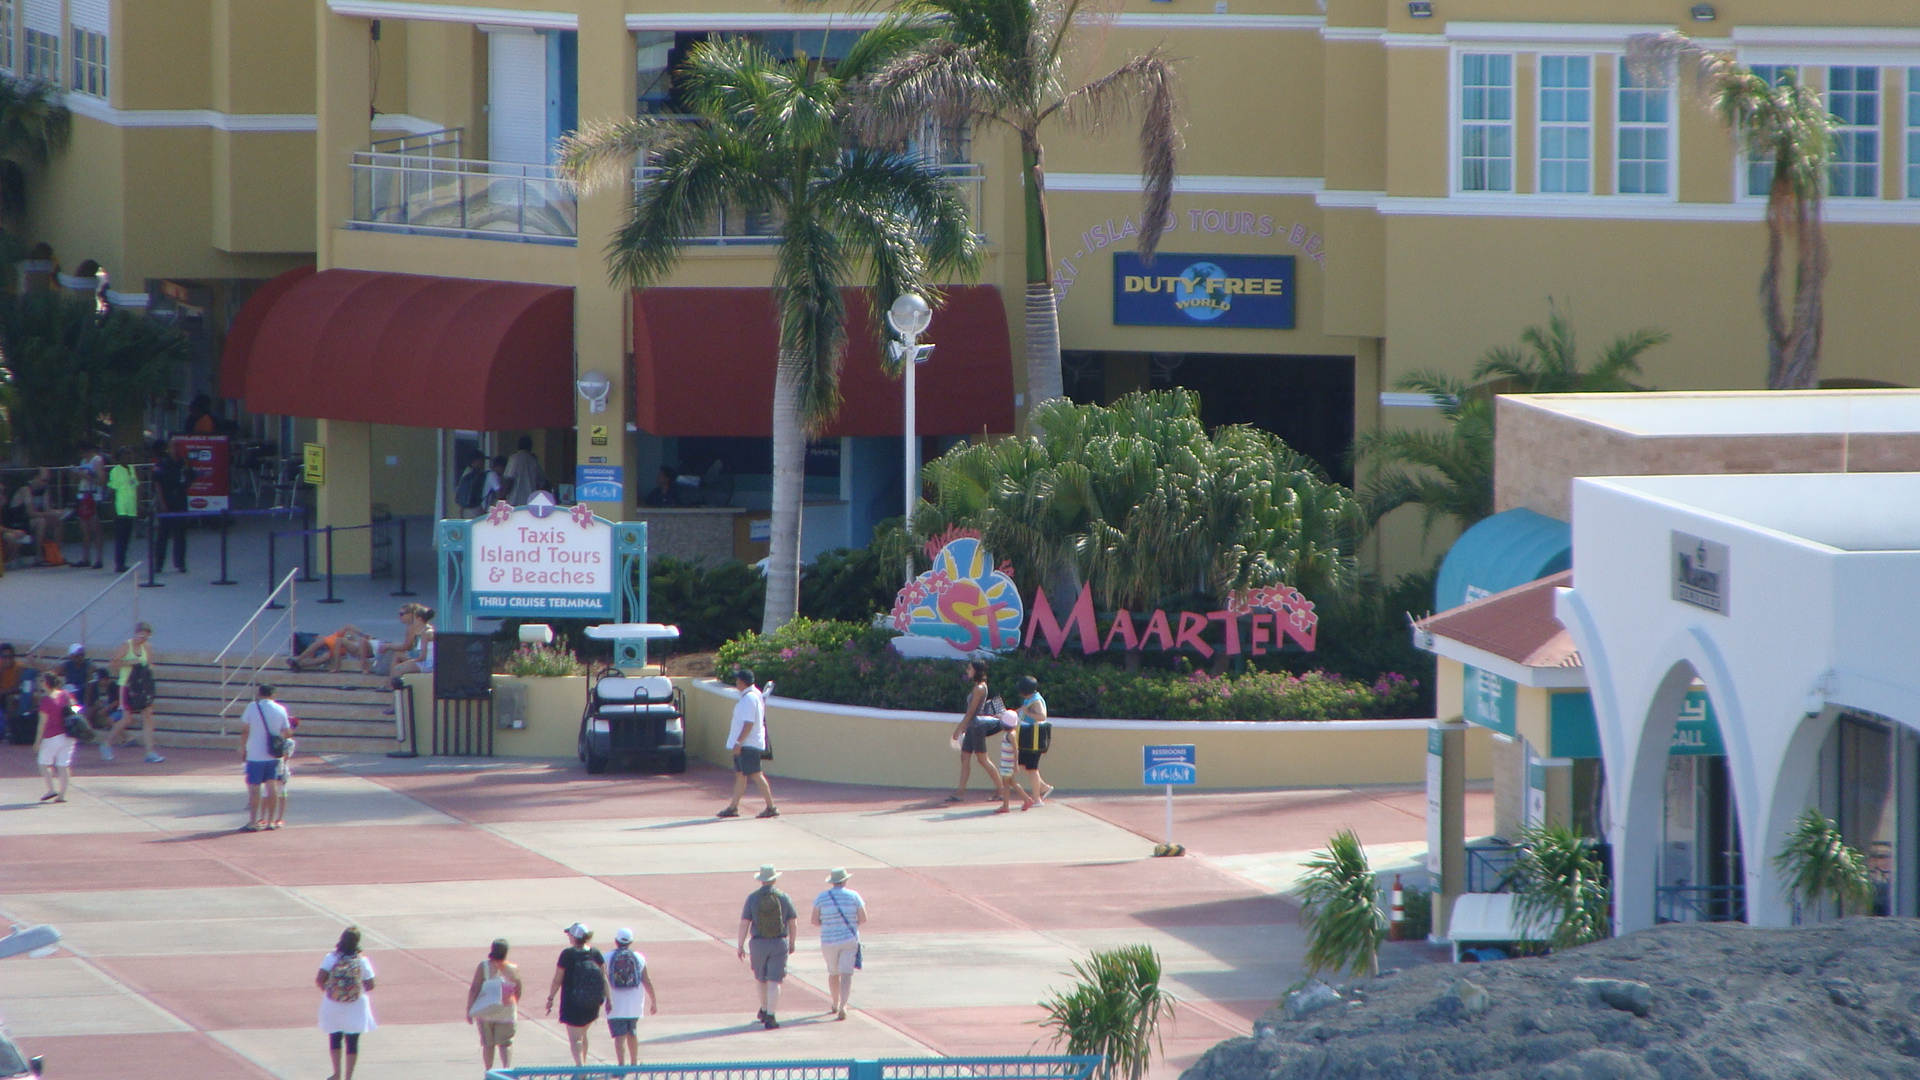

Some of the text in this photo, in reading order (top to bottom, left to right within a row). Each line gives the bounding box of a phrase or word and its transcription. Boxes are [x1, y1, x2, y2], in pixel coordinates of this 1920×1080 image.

[1082, 209, 1178, 253] ISLAD
[1124, 275, 1283, 296] DUTY FREE
[1174, 297, 1231, 311] WORLD
[518, 526, 565, 544] Taxis
[923, 522, 983, 561] Welcom
[480, 545, 601, 564] Island Tours
[488, 566, 595, 584] & Beaches
[478, 596, 602, 608] THRU CRUISE TERMINAL
